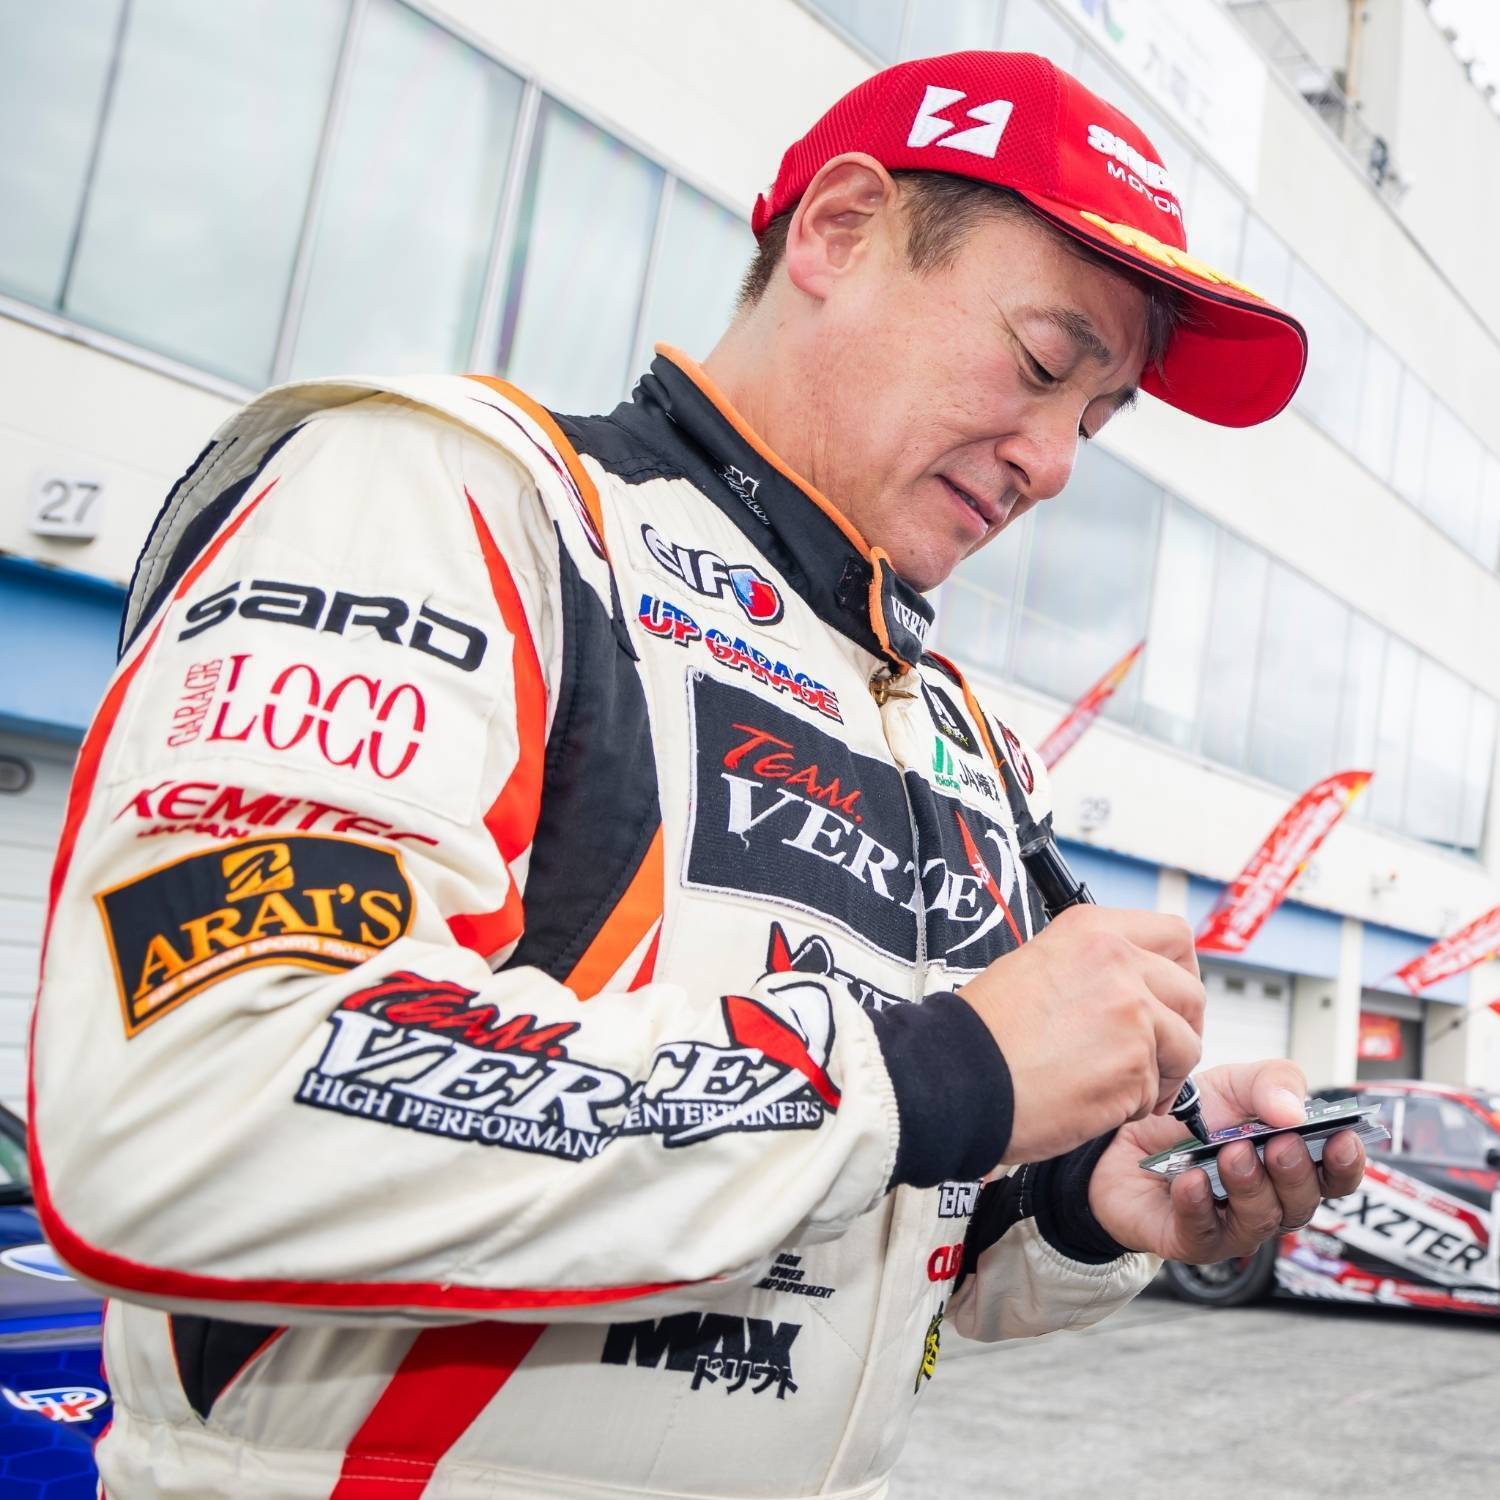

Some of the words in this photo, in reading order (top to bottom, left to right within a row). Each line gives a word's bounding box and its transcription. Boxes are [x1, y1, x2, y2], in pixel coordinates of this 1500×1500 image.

[39, 479, 99, 524] 27
[639, 593, 702, 648] UP
[704, 628, 845, 726] GARAGE
[205, 654, 427, 779] LOCO
[133, 884, 403, 1002] ARAI'S
[301, 1073, 390, 1119] HIGH
[400, 1100, 608, 1157] PERFORMAN
[600, 1311, 803, 1384] MAX
[690, 1355, 798, 1400] ドリフト
